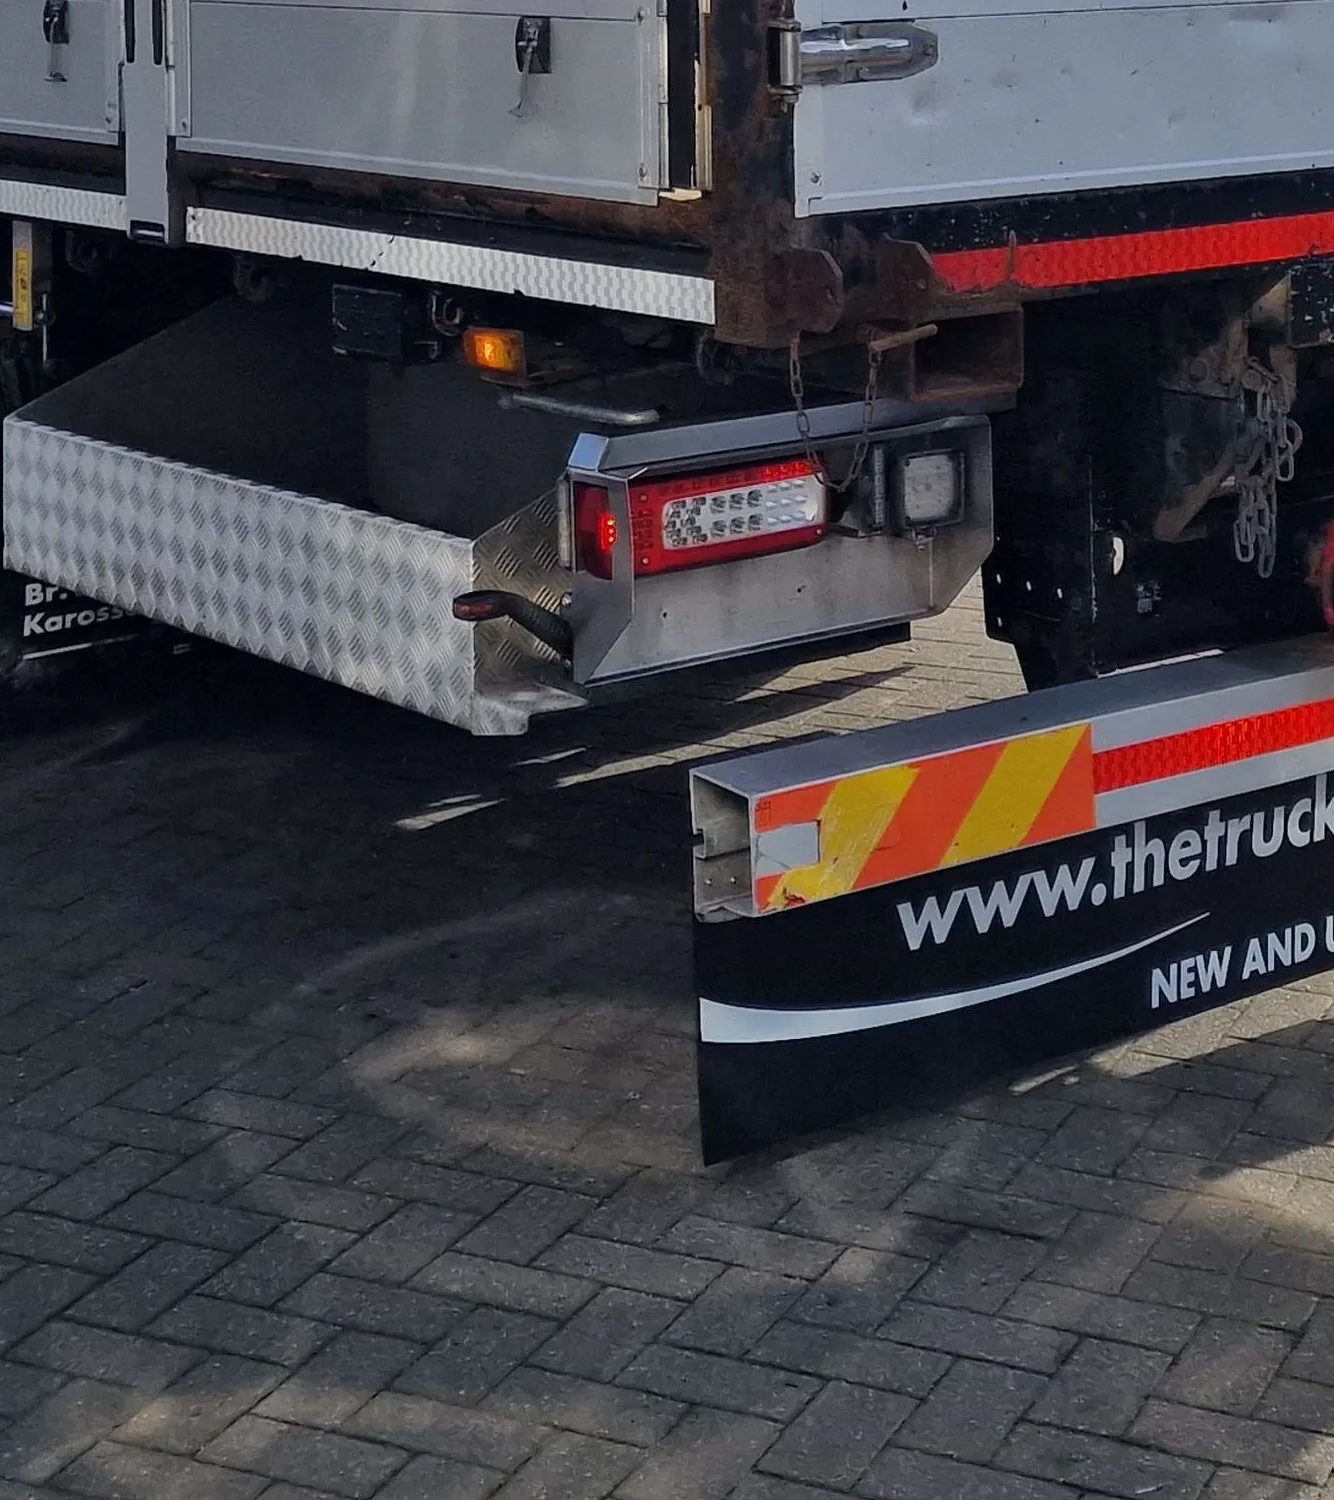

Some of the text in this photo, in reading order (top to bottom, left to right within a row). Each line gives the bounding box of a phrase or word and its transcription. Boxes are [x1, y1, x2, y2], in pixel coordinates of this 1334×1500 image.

[23, 607, 137, 637] Kaross
[1151, 946, 1231, 1008] NEW
[1242, 922, 1316, 980] AND
